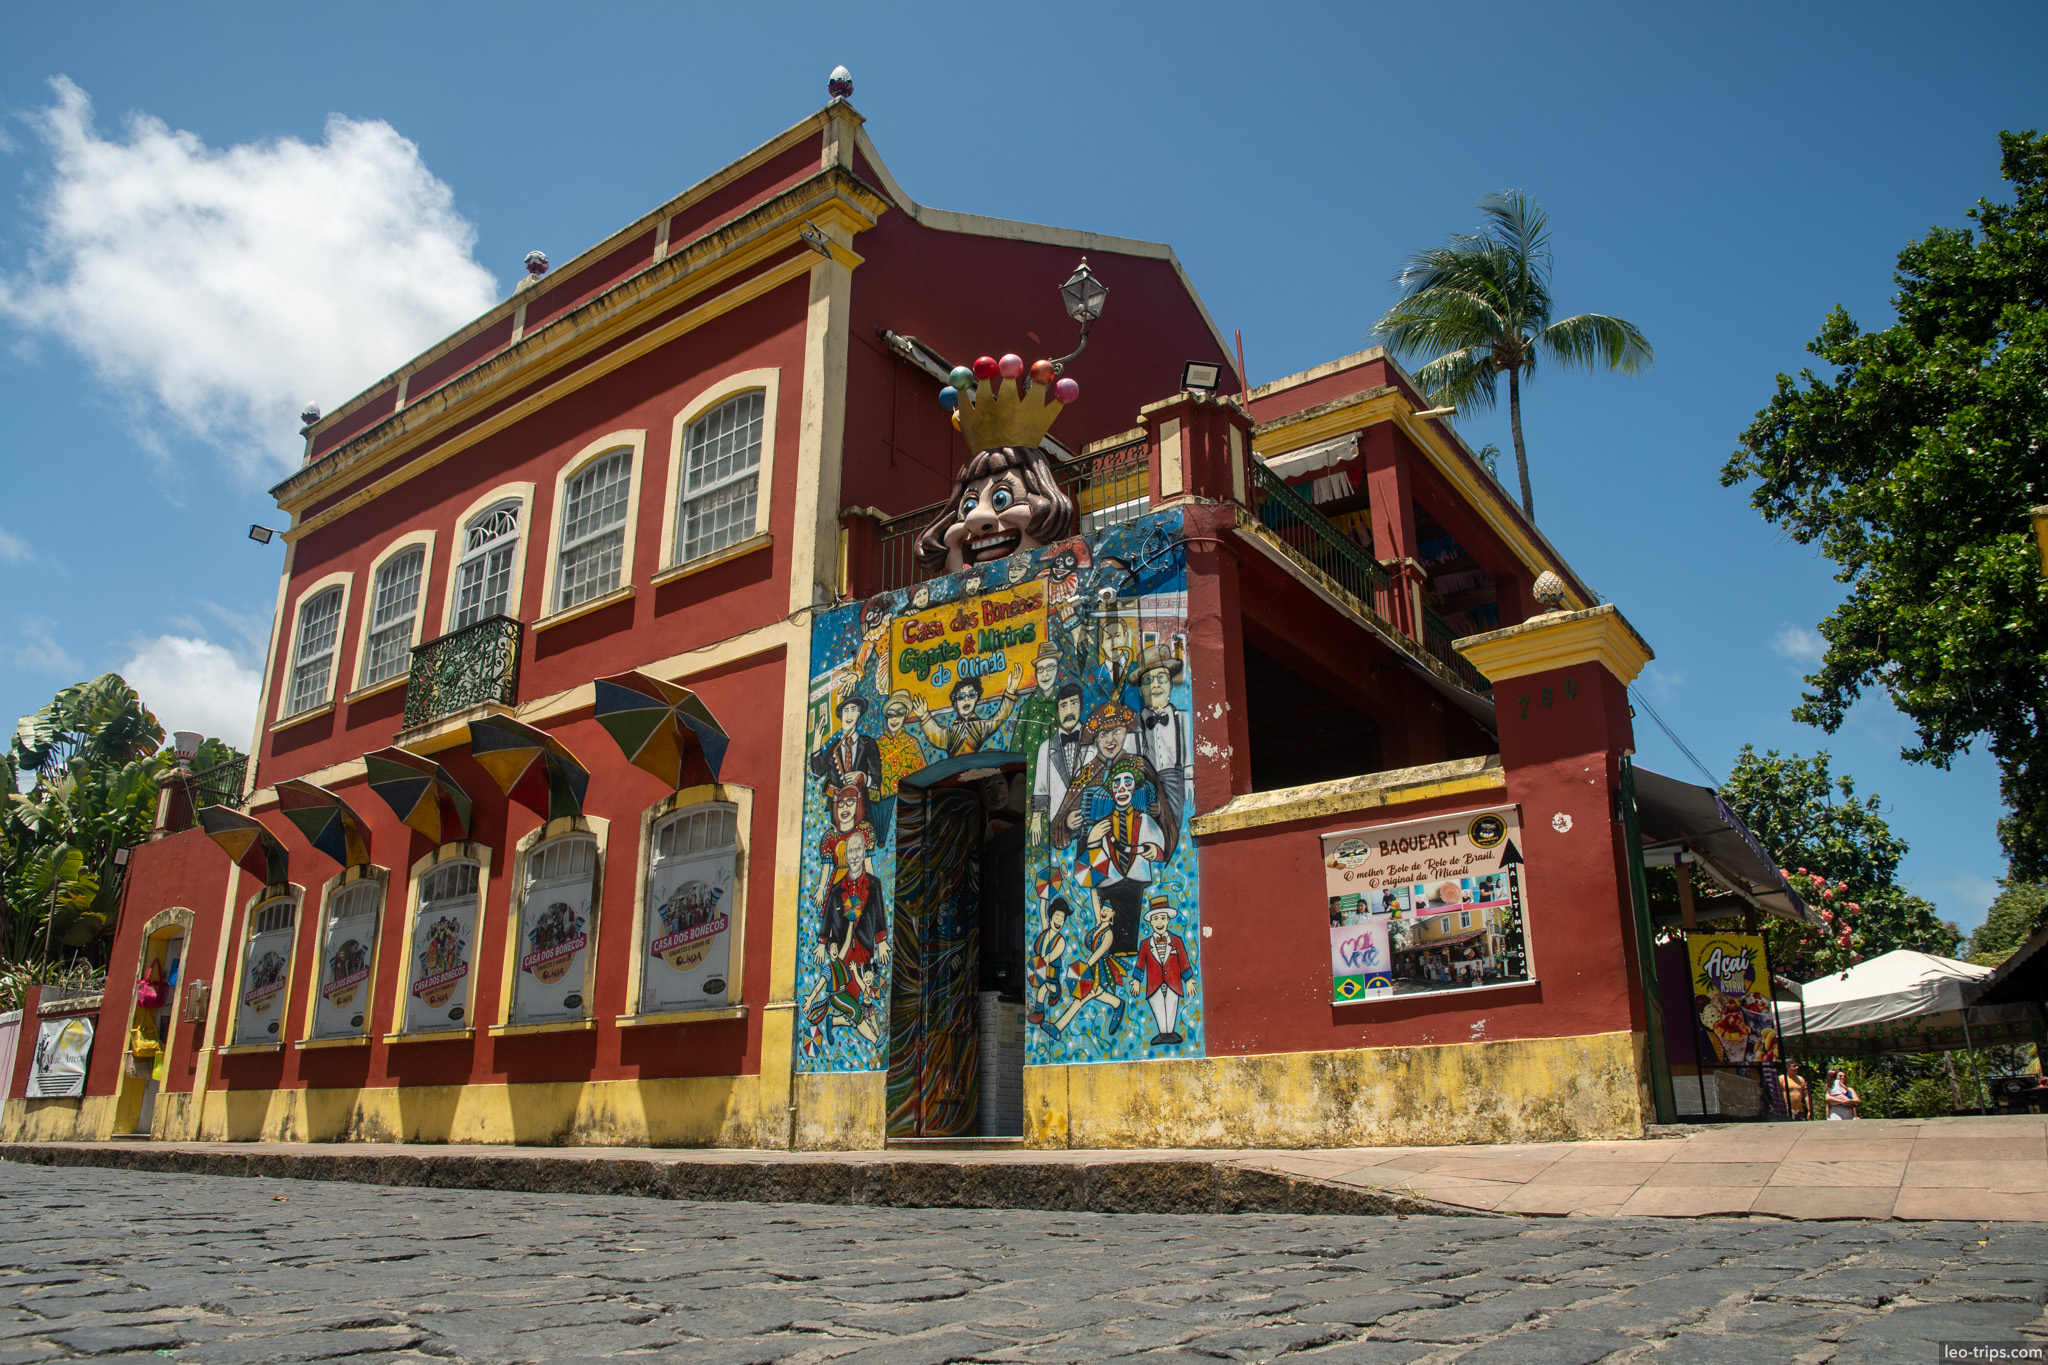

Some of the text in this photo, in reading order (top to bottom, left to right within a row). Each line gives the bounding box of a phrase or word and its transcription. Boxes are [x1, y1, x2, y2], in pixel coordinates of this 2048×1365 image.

[903, 619, 945, 644] Casa
[899, 622, 1036, 682] Gigantes & Mirins
[931, 651, 1007, 688] de Olinda
[1517, 677, 1577, 719] 780
[1378, 828, 1460, 857] BAQUEART
[1343, 850, 1495, 882] O melhor Bolo de Rolo do Brasil.
[1368, 865, 1469, 889] O original da Micaeli
[1508, 862, 1516, 876] NA
[653, 918, 725, 951] CASA DOS BONECOS
[524, 937, 585, 967] CASA DOS BONECOS
[676, 951, 703, 967] OLINDA
[1517, 944, 1527, 975] LOJA
[1703, 947, 1750, 980] Açaí
[414, 979, 428, 992] CASA
[428, 975, 440, 987] DOS
[440, 965, 466, 983] BONECOS
[1720, 980, 1746, 993] ASTRAL
